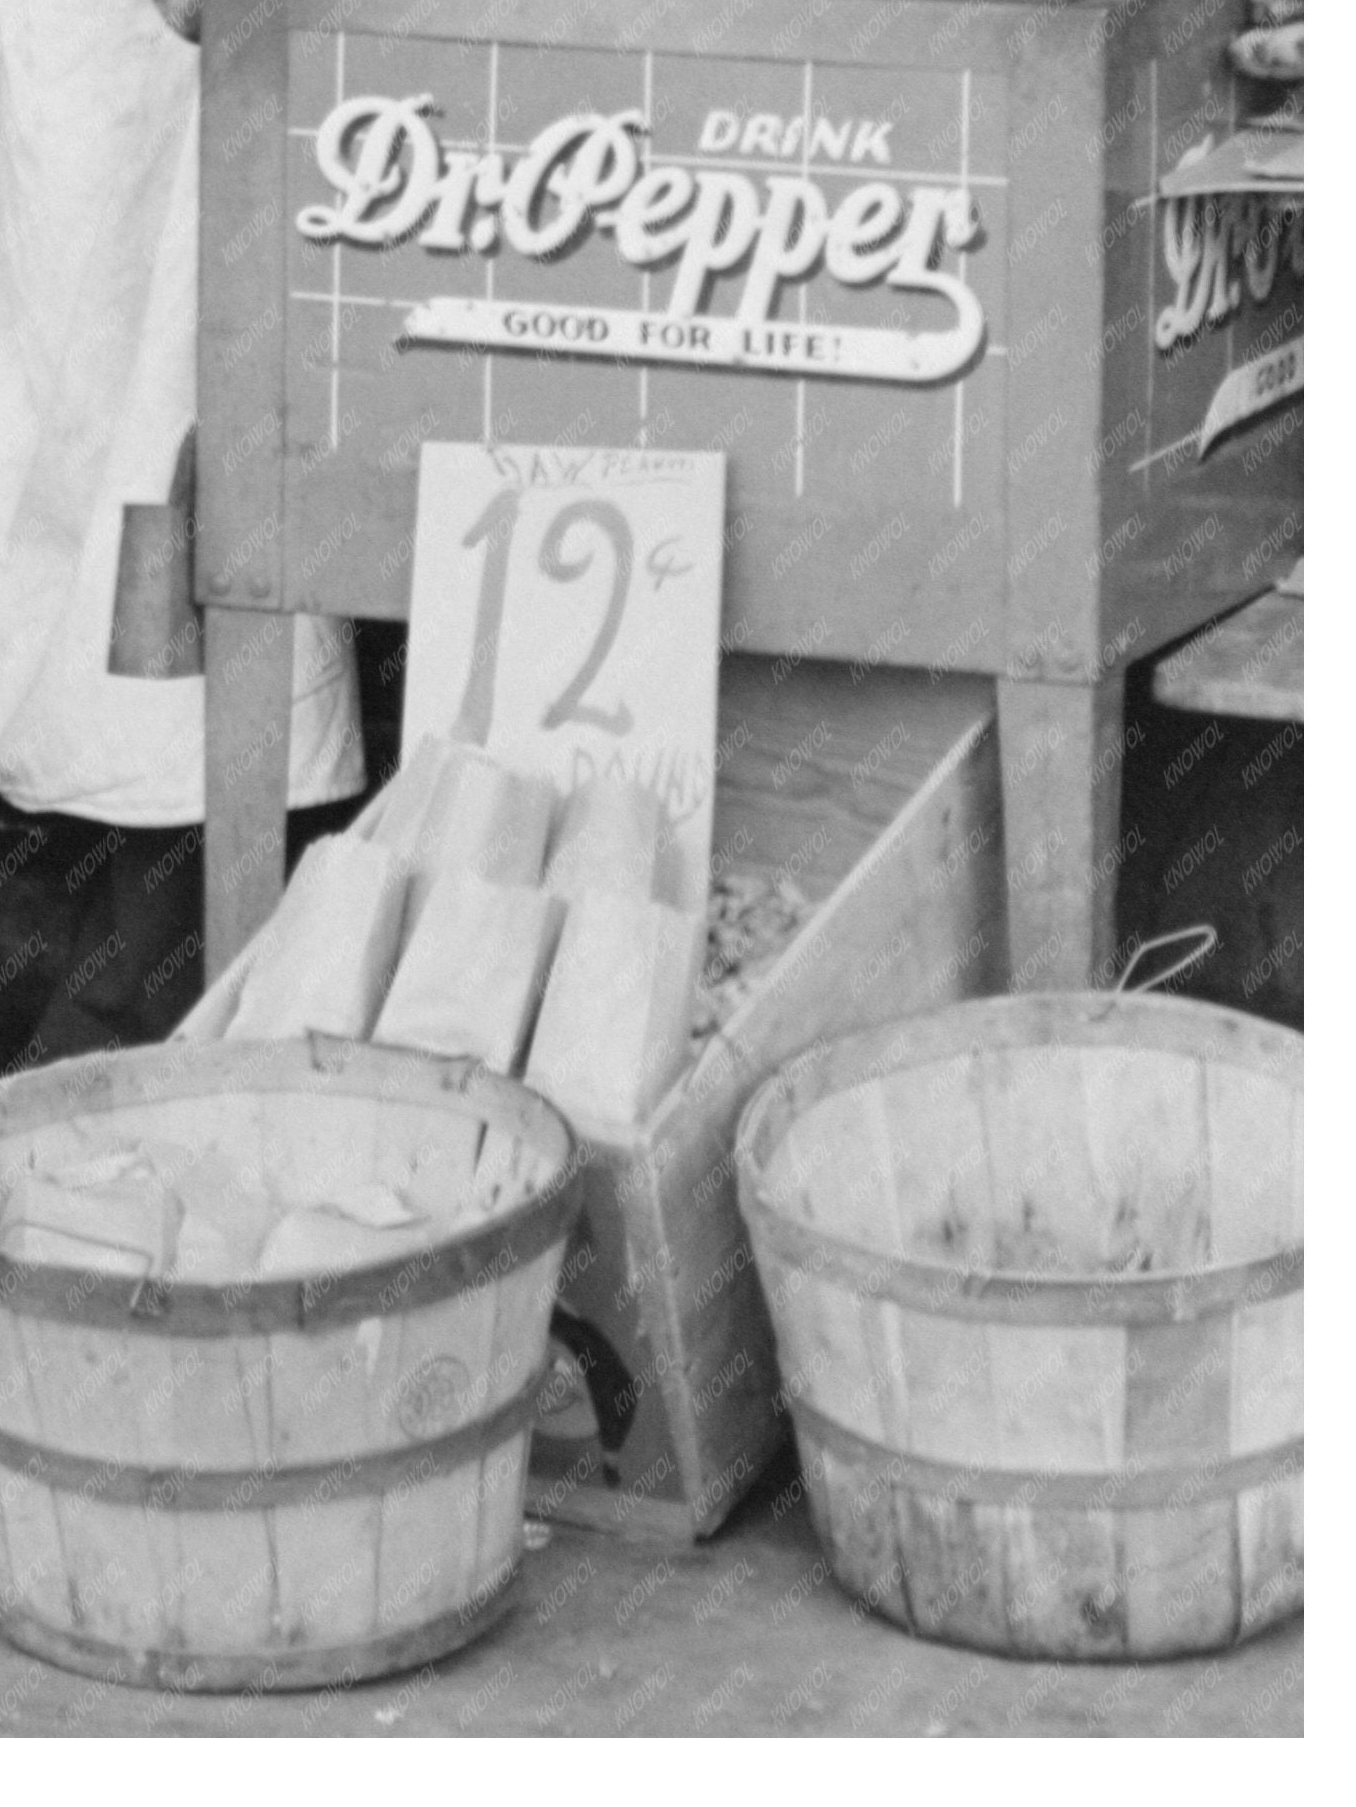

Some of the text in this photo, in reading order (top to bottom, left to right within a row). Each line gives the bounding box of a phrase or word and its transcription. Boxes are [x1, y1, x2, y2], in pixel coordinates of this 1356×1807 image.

[696, 108, 894, 164] DRINK
[502, 309, 846, 362] GOOD FOR LIFE!
